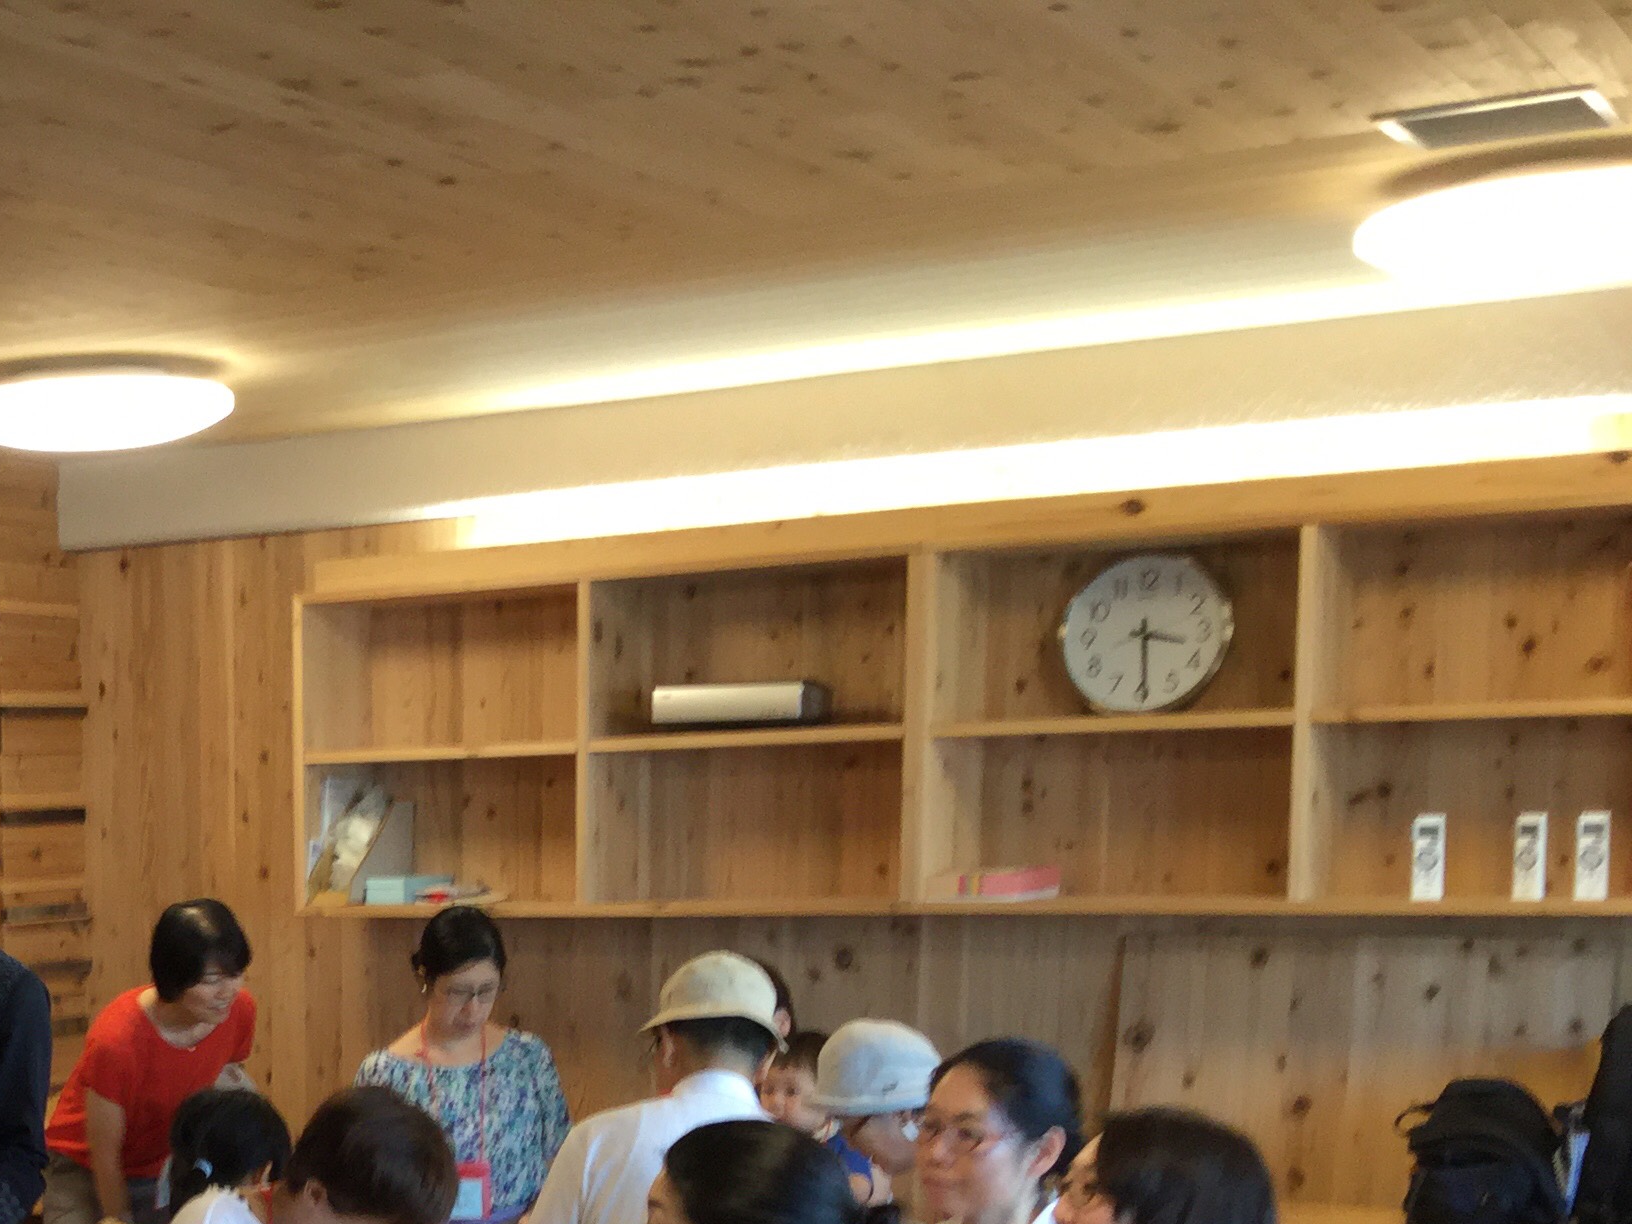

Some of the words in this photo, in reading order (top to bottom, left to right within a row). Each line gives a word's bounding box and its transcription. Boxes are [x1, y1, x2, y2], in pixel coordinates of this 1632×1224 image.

[1089, 599, 1112, 623] 10
[1188, 592, 1208, 615] 2
[1079, 626, 1099, 651] 9
[1195, 615, 1214, 643] 3
[1086, 653, 1103, 679] 8
[1184, 647, 1202, 671] 4
[1108, 671, 1125, 695] 7
